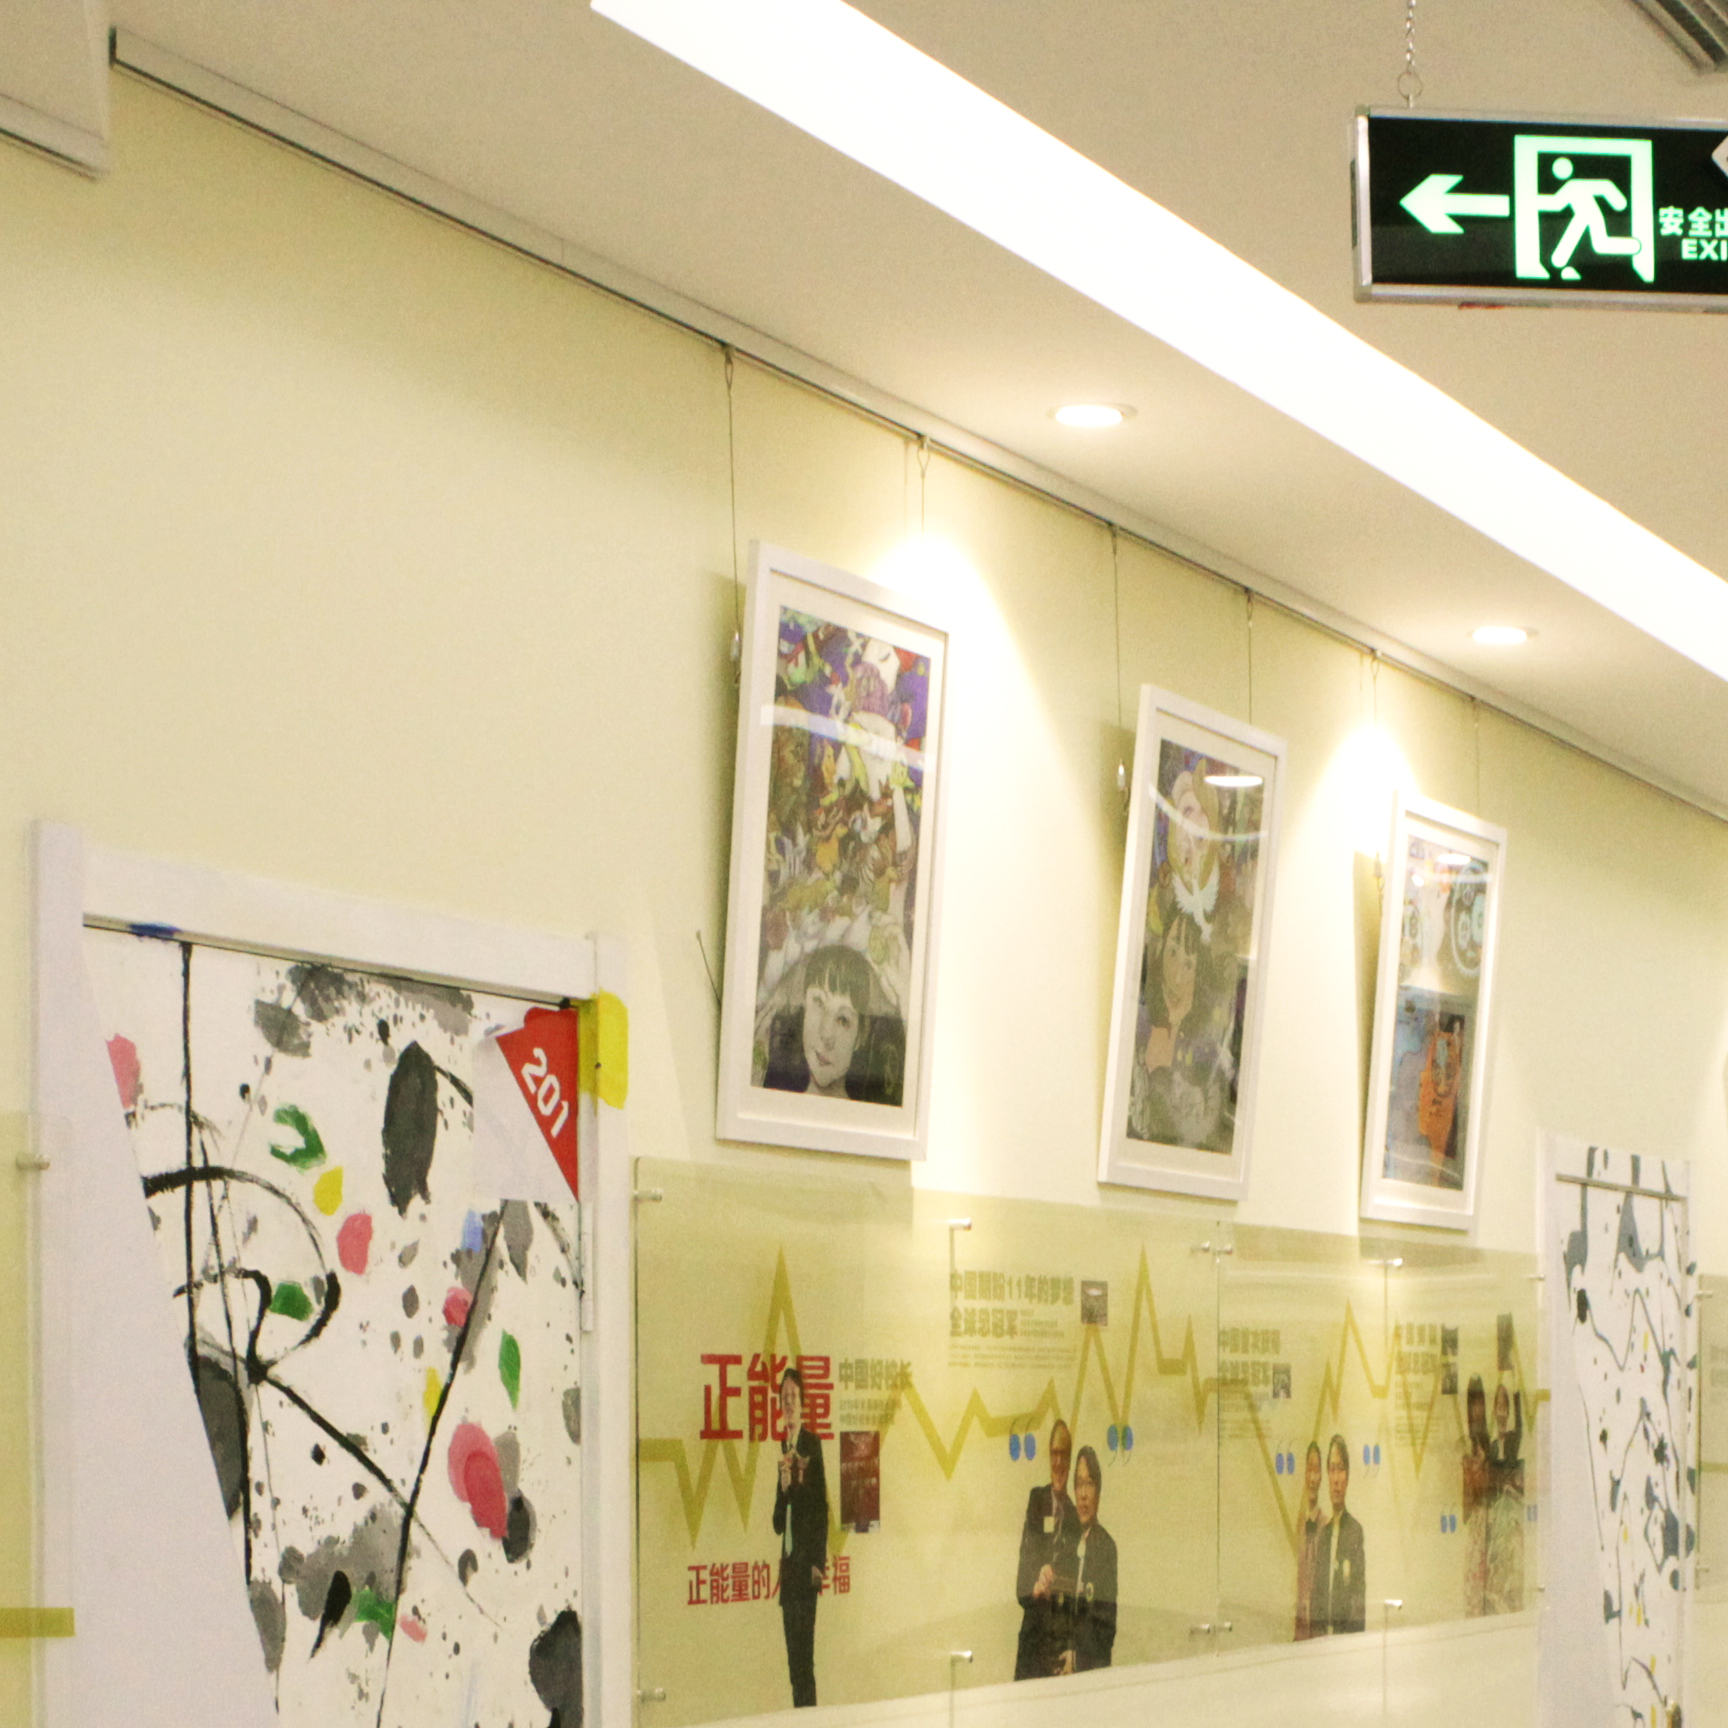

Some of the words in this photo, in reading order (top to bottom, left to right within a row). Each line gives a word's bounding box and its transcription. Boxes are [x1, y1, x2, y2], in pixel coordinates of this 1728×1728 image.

[520, 1047, 569, 1138] 201
[699, 1353, 835, 1443] 正能量
